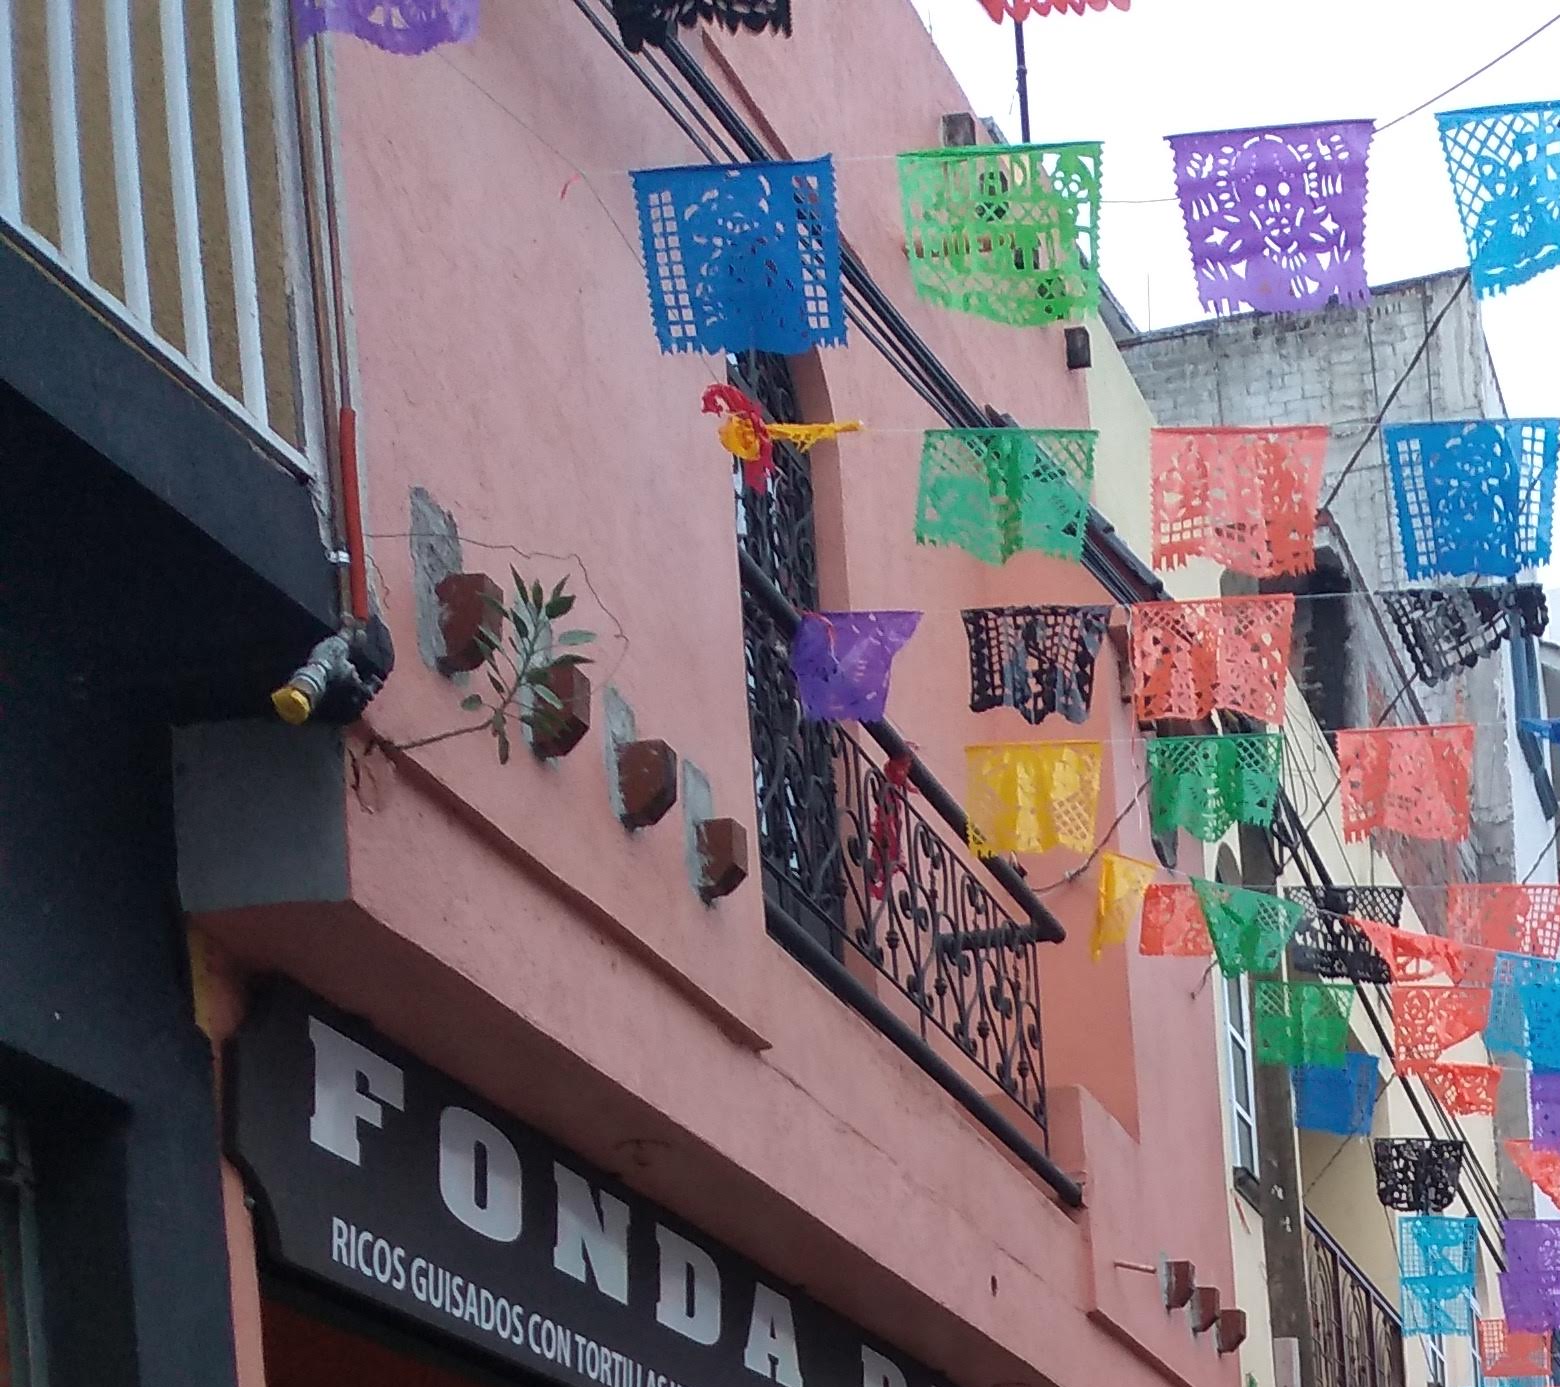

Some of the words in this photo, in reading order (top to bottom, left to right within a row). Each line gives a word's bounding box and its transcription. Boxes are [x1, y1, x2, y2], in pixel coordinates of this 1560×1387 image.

[332, 1216, 406, 1290] RICOS
[411, 1257, 524, 1346] GUISADOS
[528, 1313, 571, 1368] CON
